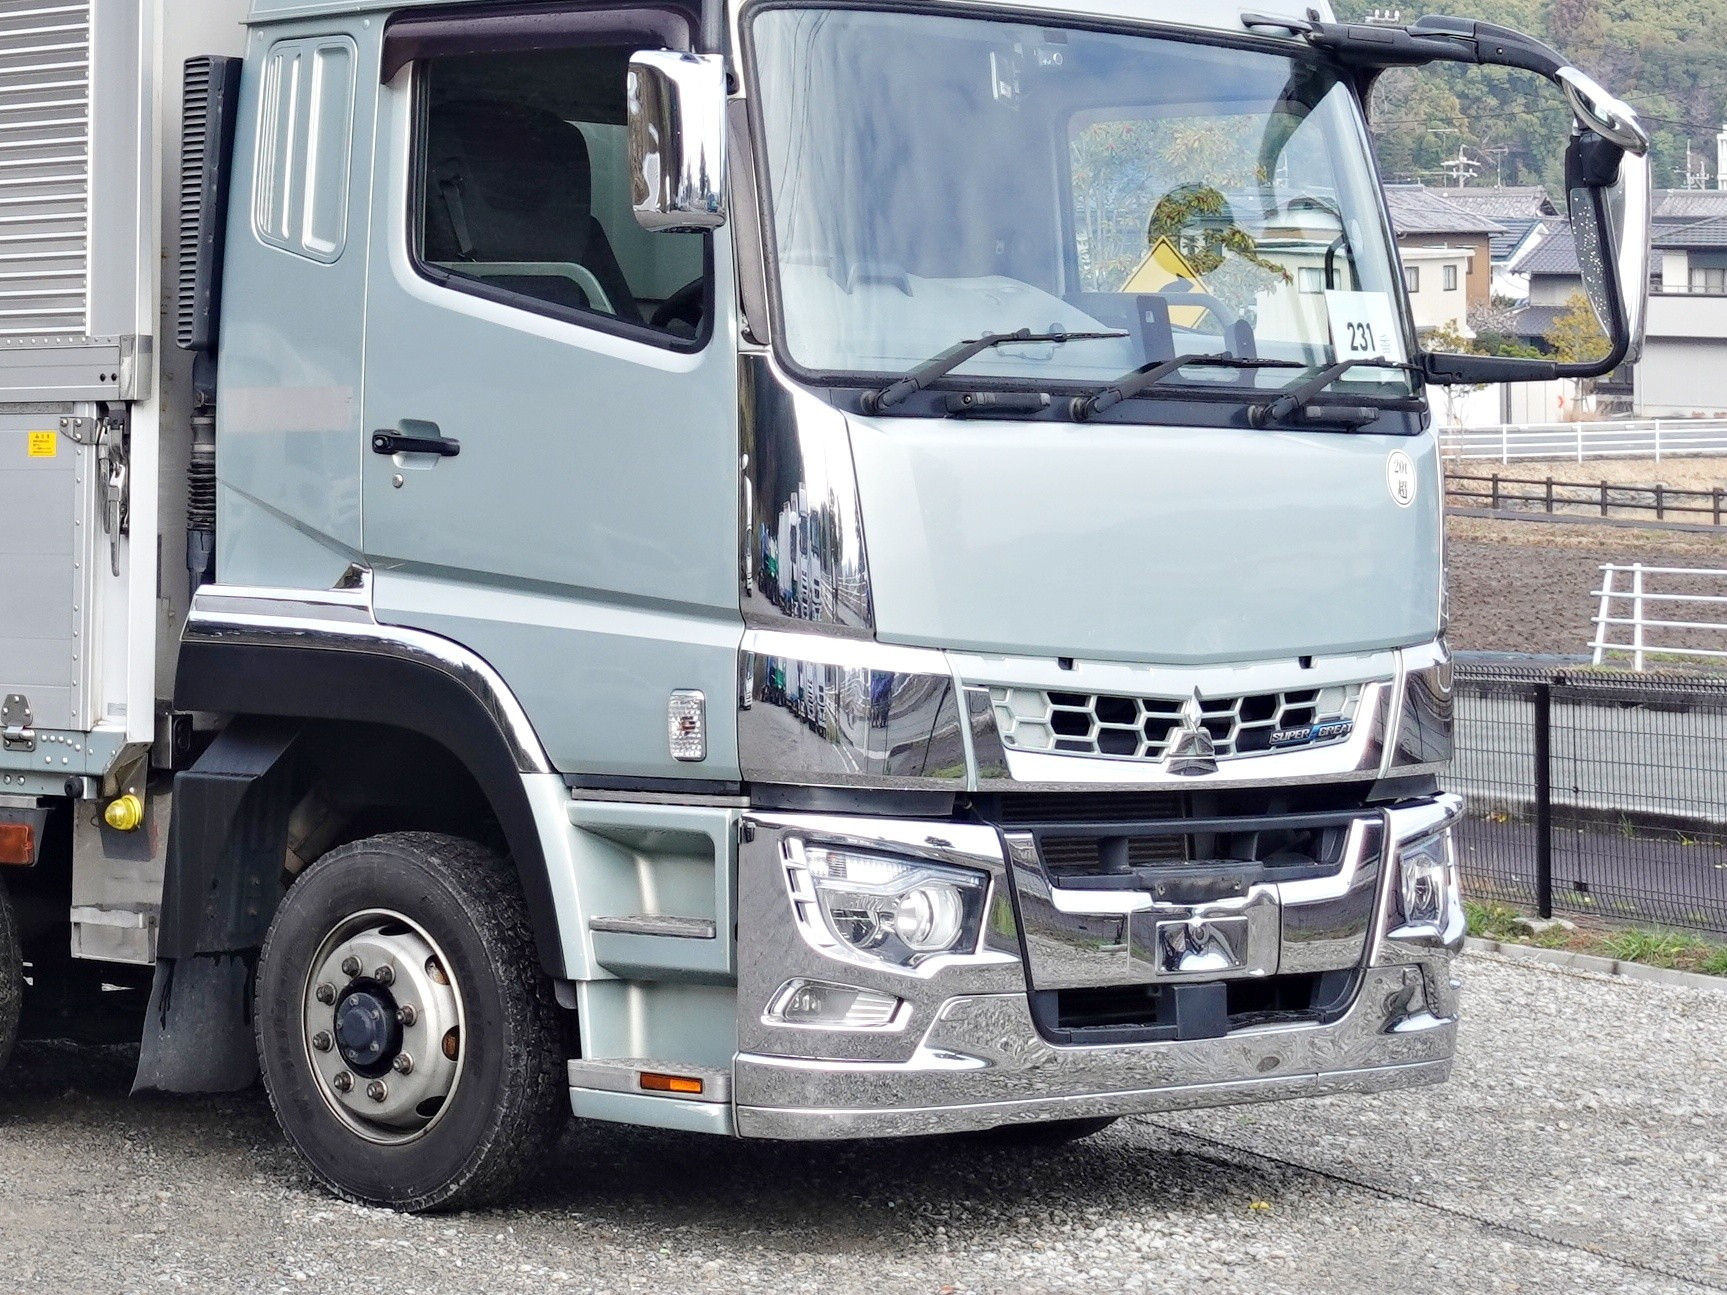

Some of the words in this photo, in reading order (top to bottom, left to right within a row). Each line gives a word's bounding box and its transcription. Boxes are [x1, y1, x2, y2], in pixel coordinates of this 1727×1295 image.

[1347, 322, 1376, 352] 231
[1273, 728, 1310, 741] SUPER
[1318, 723, 1352, 737] GREAT
